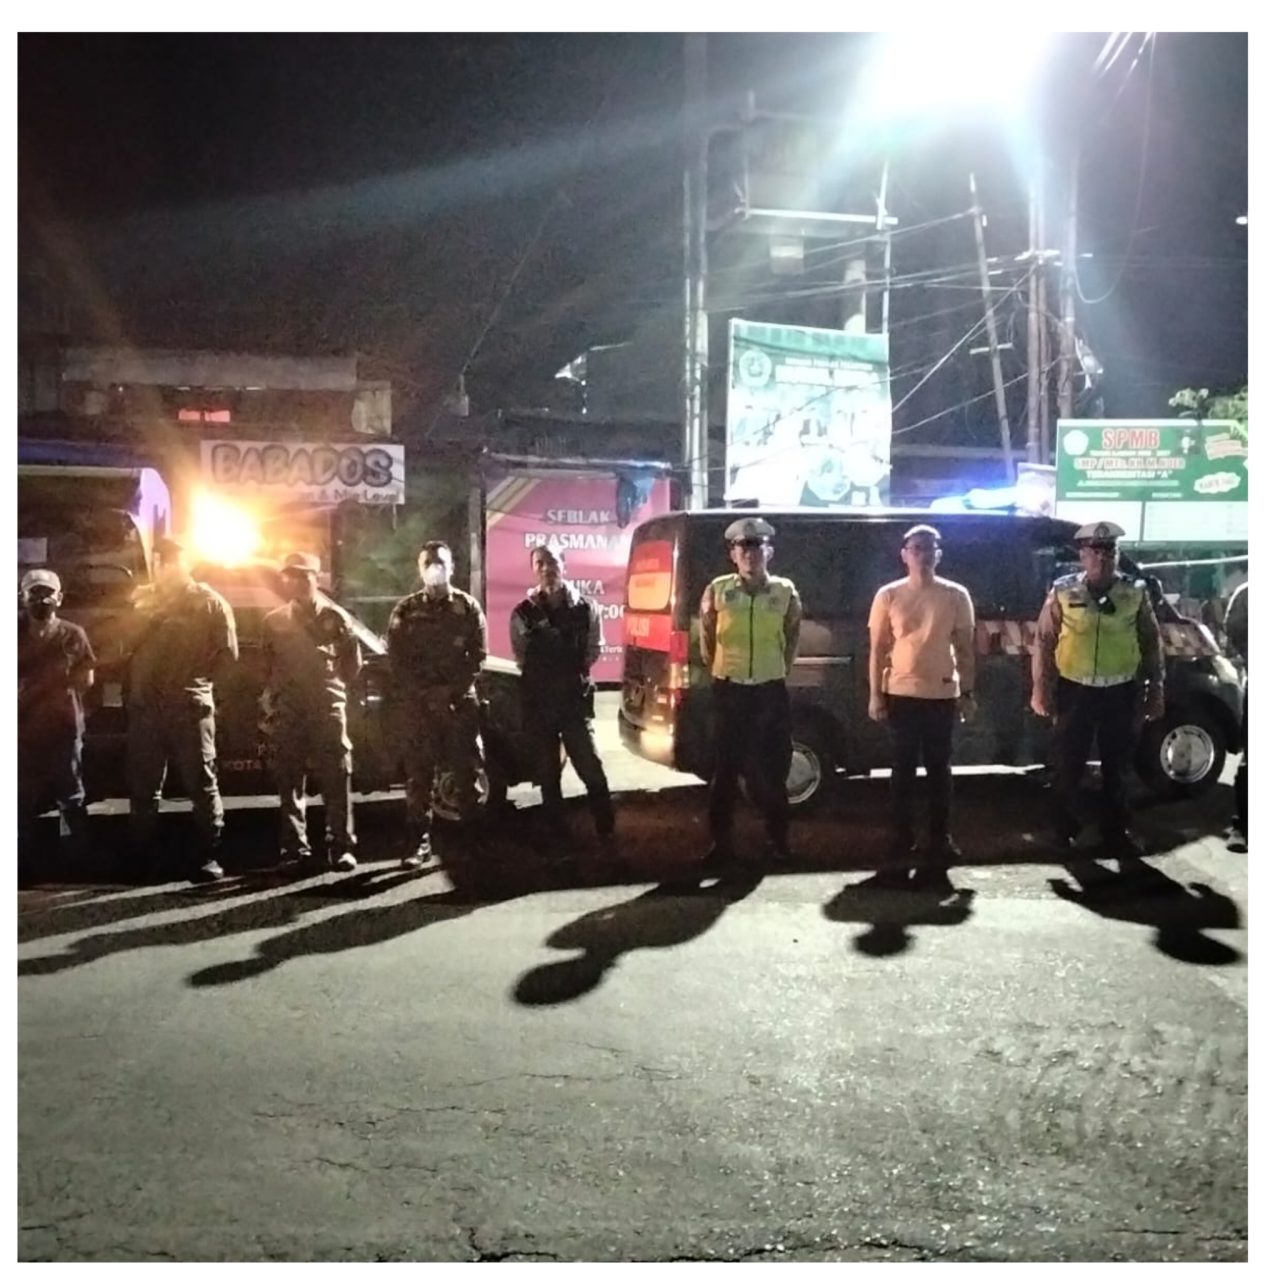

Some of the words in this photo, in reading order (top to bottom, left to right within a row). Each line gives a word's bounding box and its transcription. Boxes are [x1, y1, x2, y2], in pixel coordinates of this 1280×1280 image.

[1102, 428, 1160, 449] SPMB
[211, 443, 394, 487] BABADOS
[546, 509, 611, 524] SEBLAK
